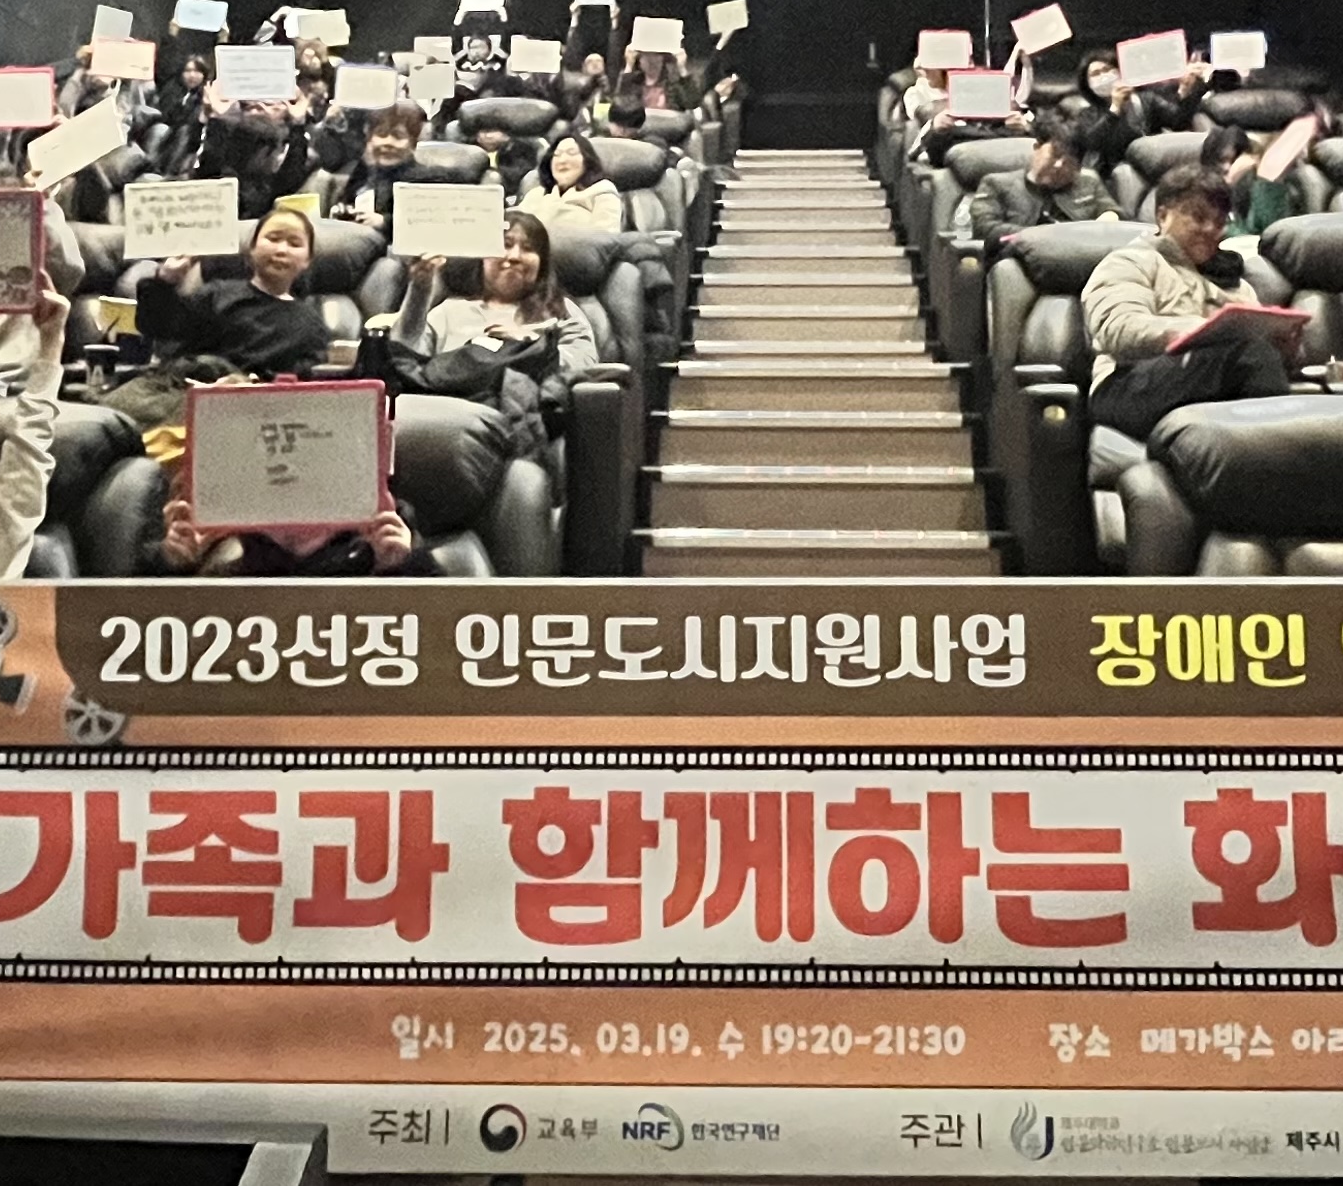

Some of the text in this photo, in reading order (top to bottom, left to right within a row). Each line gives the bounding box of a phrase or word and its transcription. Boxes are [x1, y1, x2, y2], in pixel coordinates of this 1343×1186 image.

[99, 615, 420, 688] 2023선정
[457, 613, 1027, 688] 인문도시지원사업
[1090, 612, 1307, 688] 장애인
[501, 785, 1131, 949] 함께하는
[390, 1013, 968, 1061] 일시 2025. 03.19. 수 19:20-21:30
[1048, 1022, 1112, 1063] 장소
[1140, 1021, 1275, 1062] 메가박스
[367, 1109, 432, 1146] 주최
[536, 1117, 599, 1142] 교육부
[621, 1121, 671, 1141] NRF
[899, 1113, 966, 1149] 주관
[1285, 1130, 1341, 1153] 제주시
